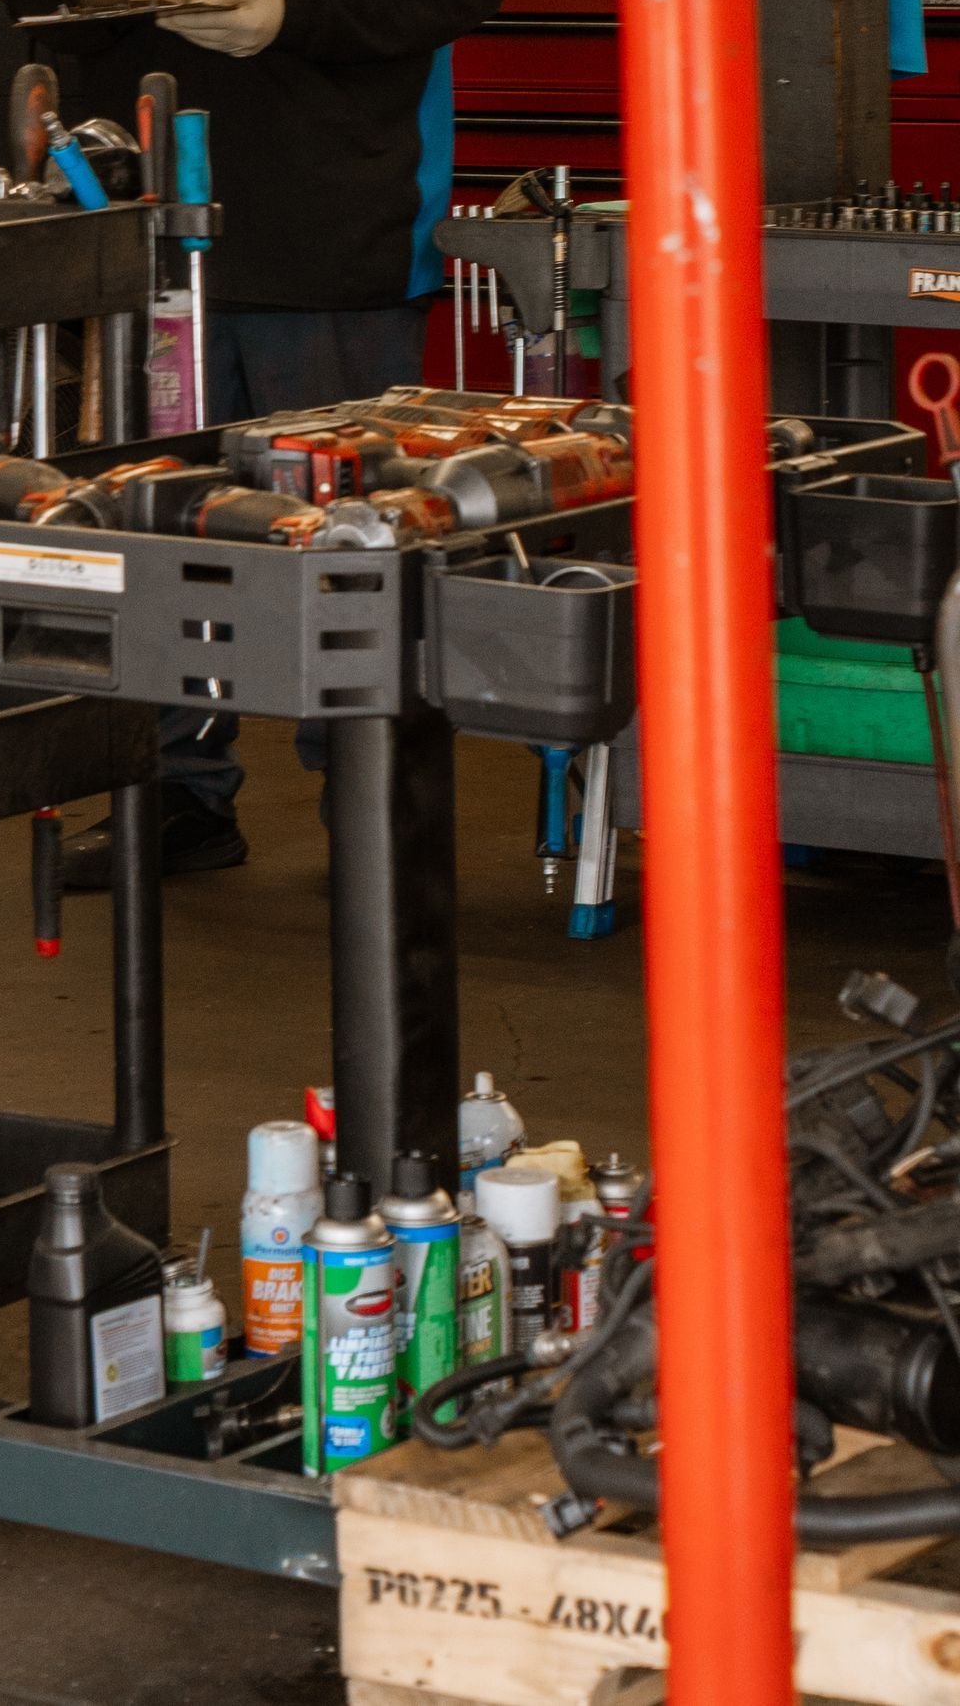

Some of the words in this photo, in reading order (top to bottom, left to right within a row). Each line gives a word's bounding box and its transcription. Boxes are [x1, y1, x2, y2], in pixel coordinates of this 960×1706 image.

[911, 271, 960, 293] FRAN
[251, 1280, 304, 1302] BRAK
[327, 1331, 393, 1354] LIMPIA
[548, 1594, 660, 1642] 48X4
